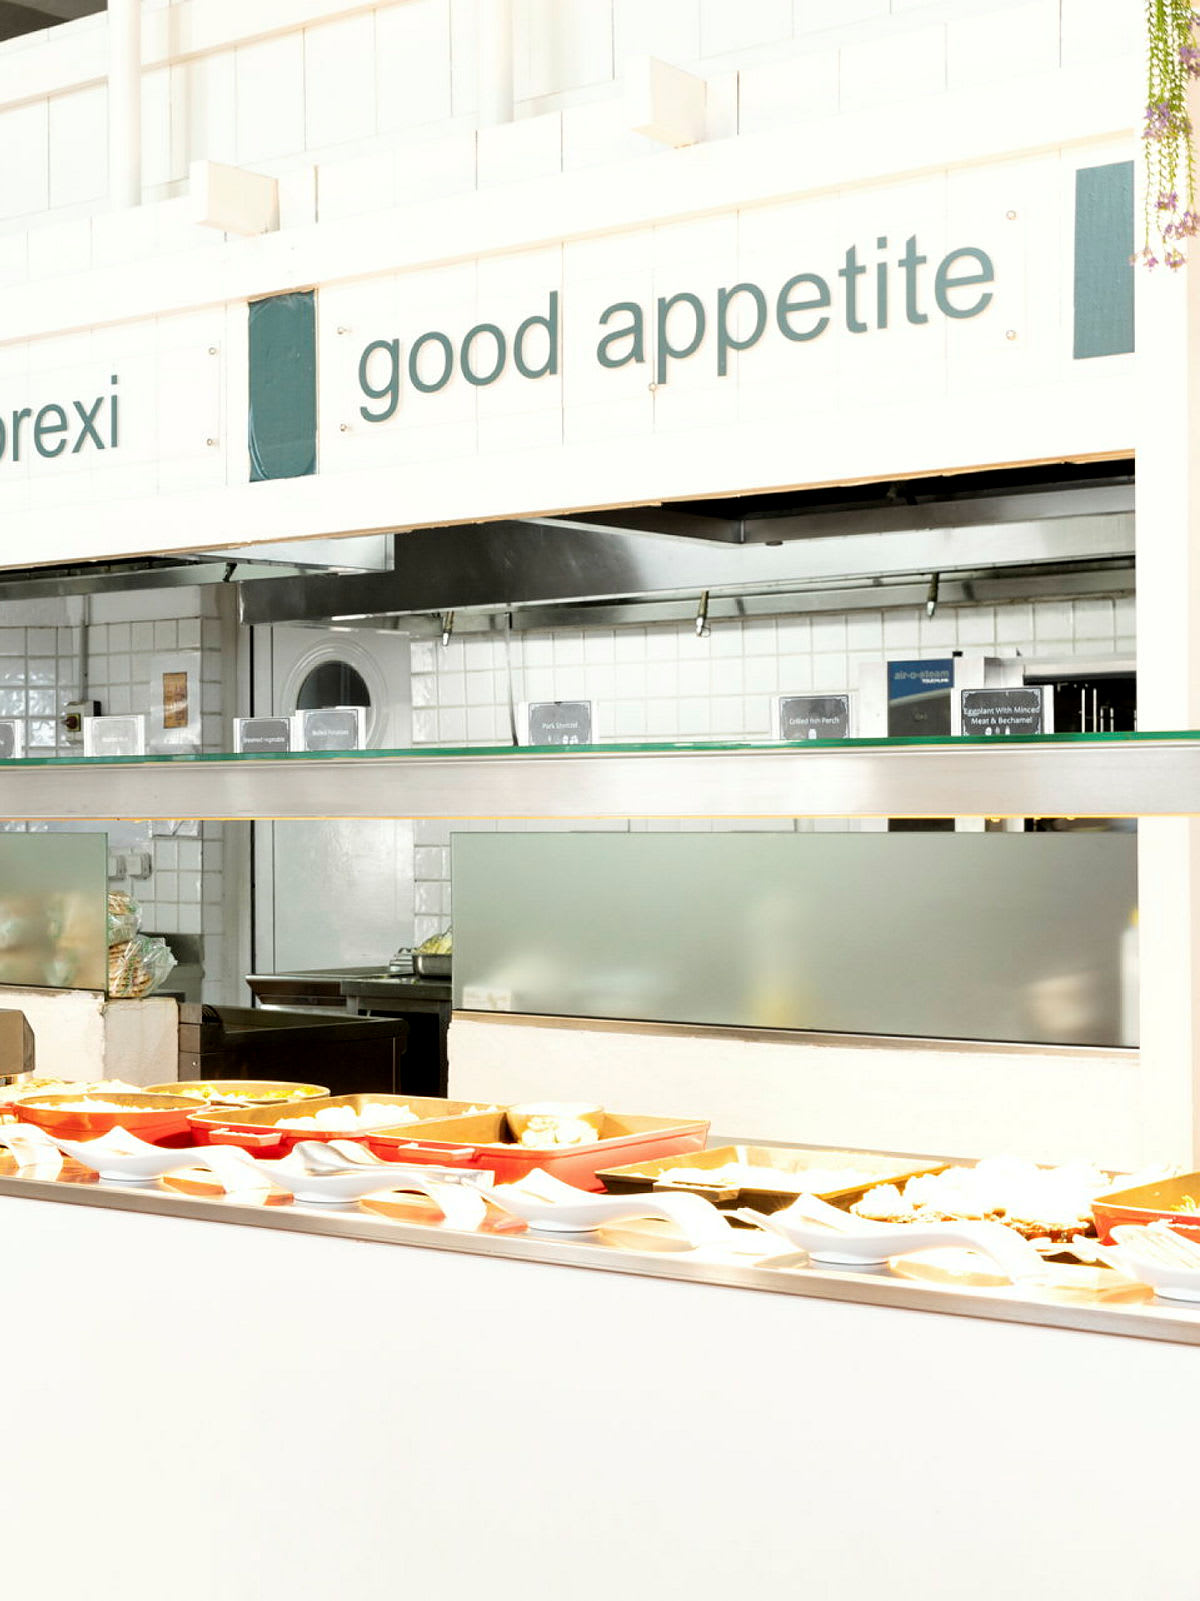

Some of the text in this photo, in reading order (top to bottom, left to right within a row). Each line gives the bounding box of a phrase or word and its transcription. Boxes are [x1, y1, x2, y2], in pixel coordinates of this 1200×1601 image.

[357, 234, 996, 424] good appetite
[963, 705, 1040, 717] Eggplant With Minced
[970, 715, 1033, 725] Meat & Bechamel
